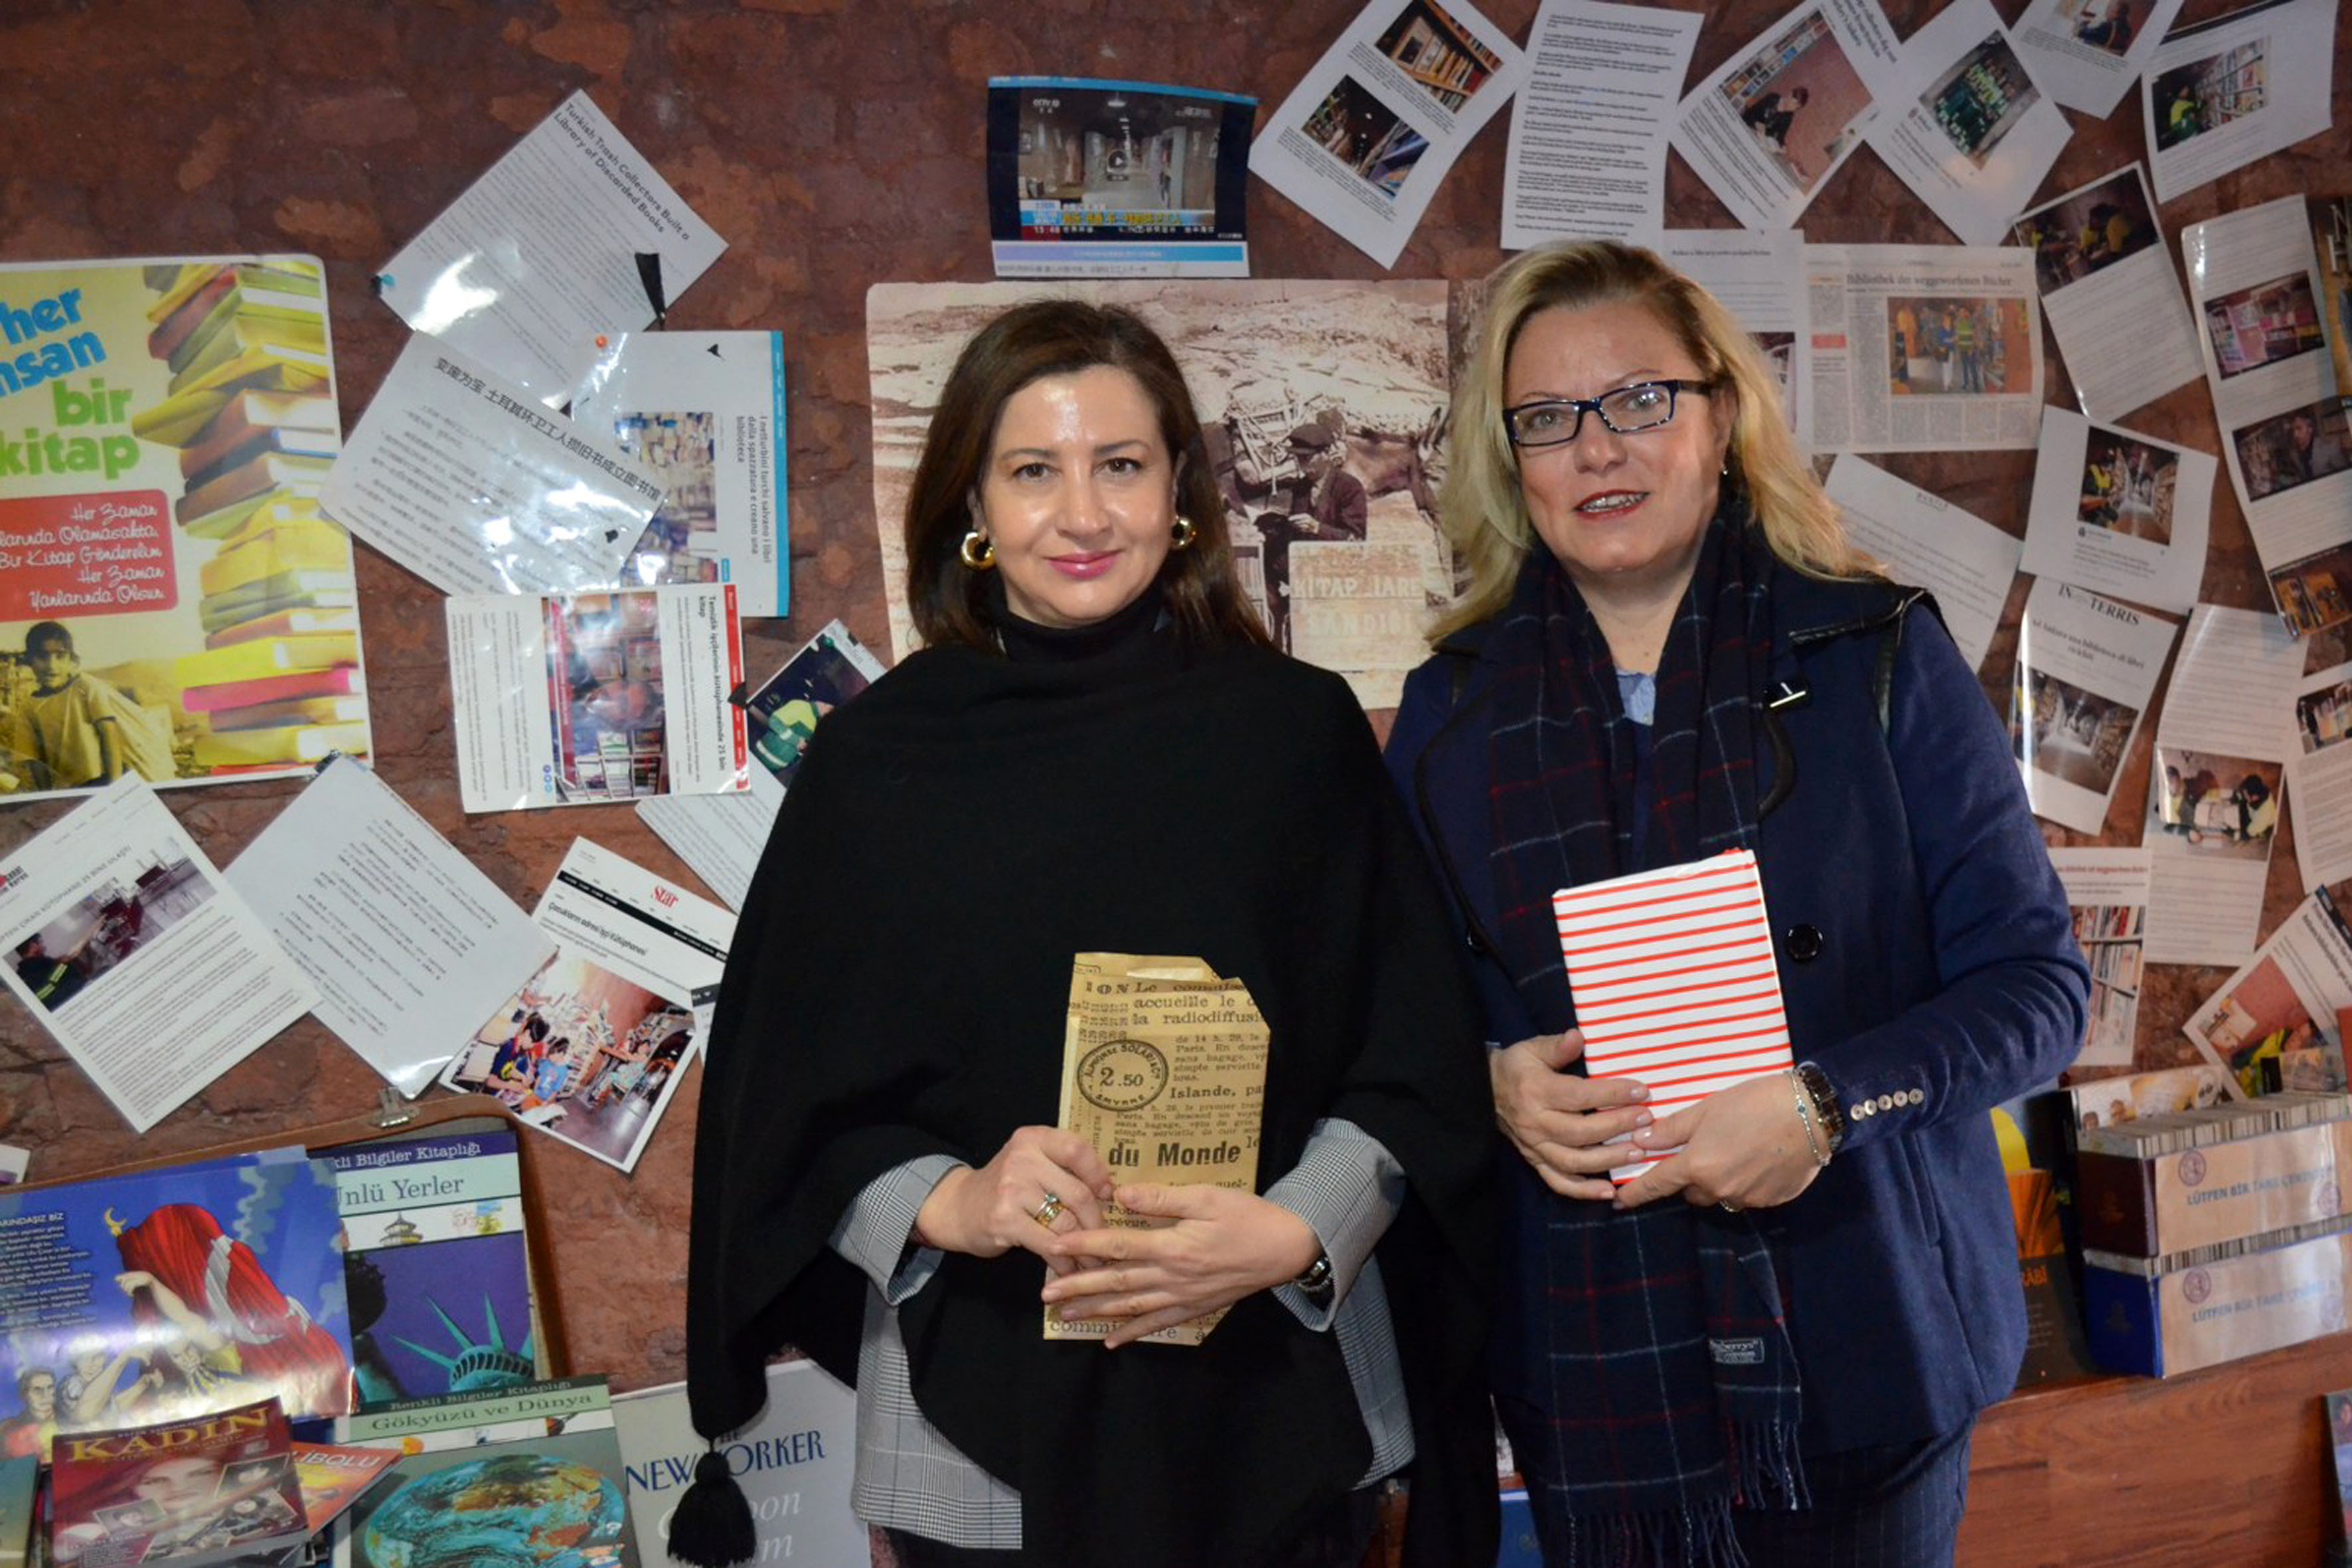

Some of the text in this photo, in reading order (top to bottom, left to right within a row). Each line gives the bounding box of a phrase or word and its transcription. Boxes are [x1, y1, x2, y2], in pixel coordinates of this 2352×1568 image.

[554, 112, 665, 232] Library of Discarded Books
[565, 103, 595, 139] Turkish
[596, 136, 619, 166] Trash
[619, 163, 662, 211] Collectors
[661, 208, 682, 233] Built
[0, 287, 82, 345] her
[52, 377, 133, 427] bir
[0, 428, 140, 480] kitap
[2091, 597, 2140, 625] TERRIS
[1133, 995, 1235, 1009] accueille le
[1132, 1012, 1149, 1025] la
[1170, 1085, 1236, 1099] Islande,
[355, 1150, 412, 1167] Bilgiler
[416, 1141, 481, 1160] Kitaplığı
[1109, 1140, 1241, 1167] du Monde
[391, 1174, 465, 1200] Yerler
[2187, 1187, 2228, 1206] LÜTFEN
[2231, 1182, 2249, 1196] BİR
[372, 1393, 593, 1432] Gökyüzü ve Dünya
[390, 1396, 442, 1411] Renkli
[444, 1390, 500, 1404] Bilgiler
[72, 1407, 270, 1460] KADIN
[291, 1449, 382, 1469] İBOLU
[625, 1430, 825, 1494] NEW ORKER
